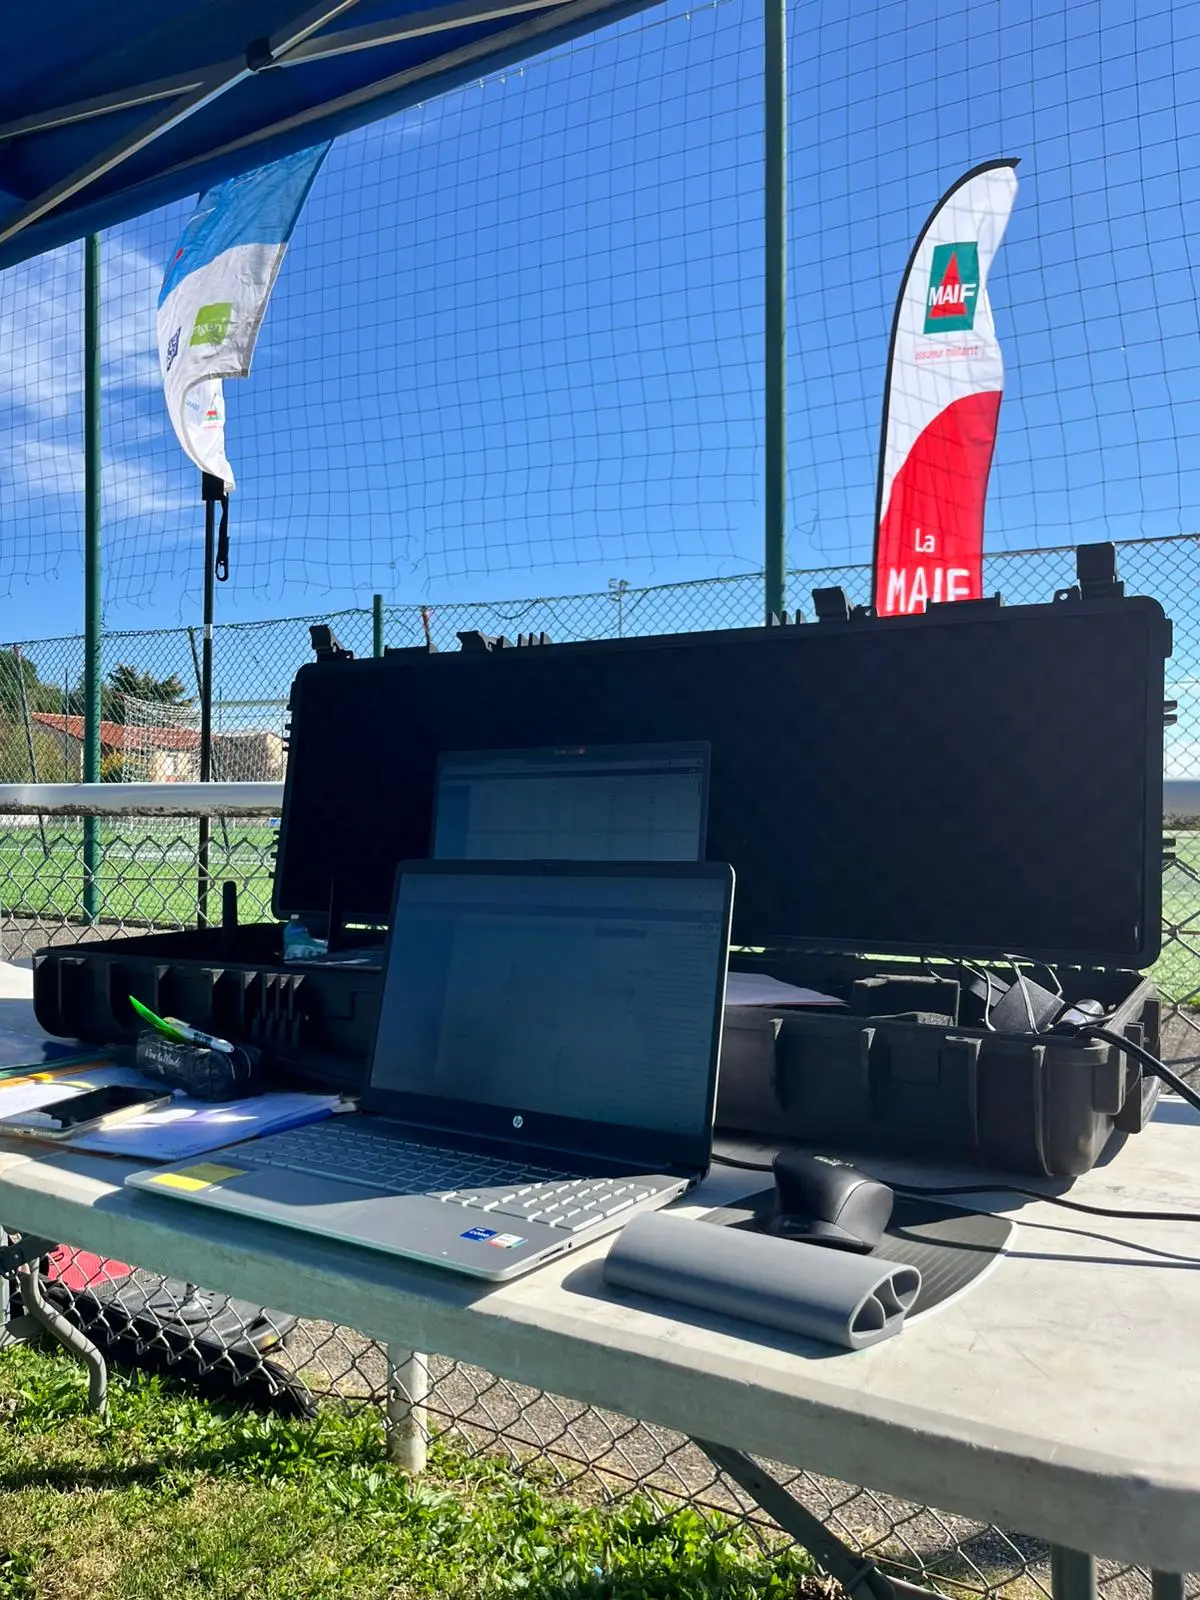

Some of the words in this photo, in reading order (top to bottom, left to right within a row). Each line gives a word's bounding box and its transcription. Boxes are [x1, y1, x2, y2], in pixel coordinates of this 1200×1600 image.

[928, 283, 977, 306] MAIF
[914, 527, 935, 553] La
[885, 566, 970, 613] MAIF
